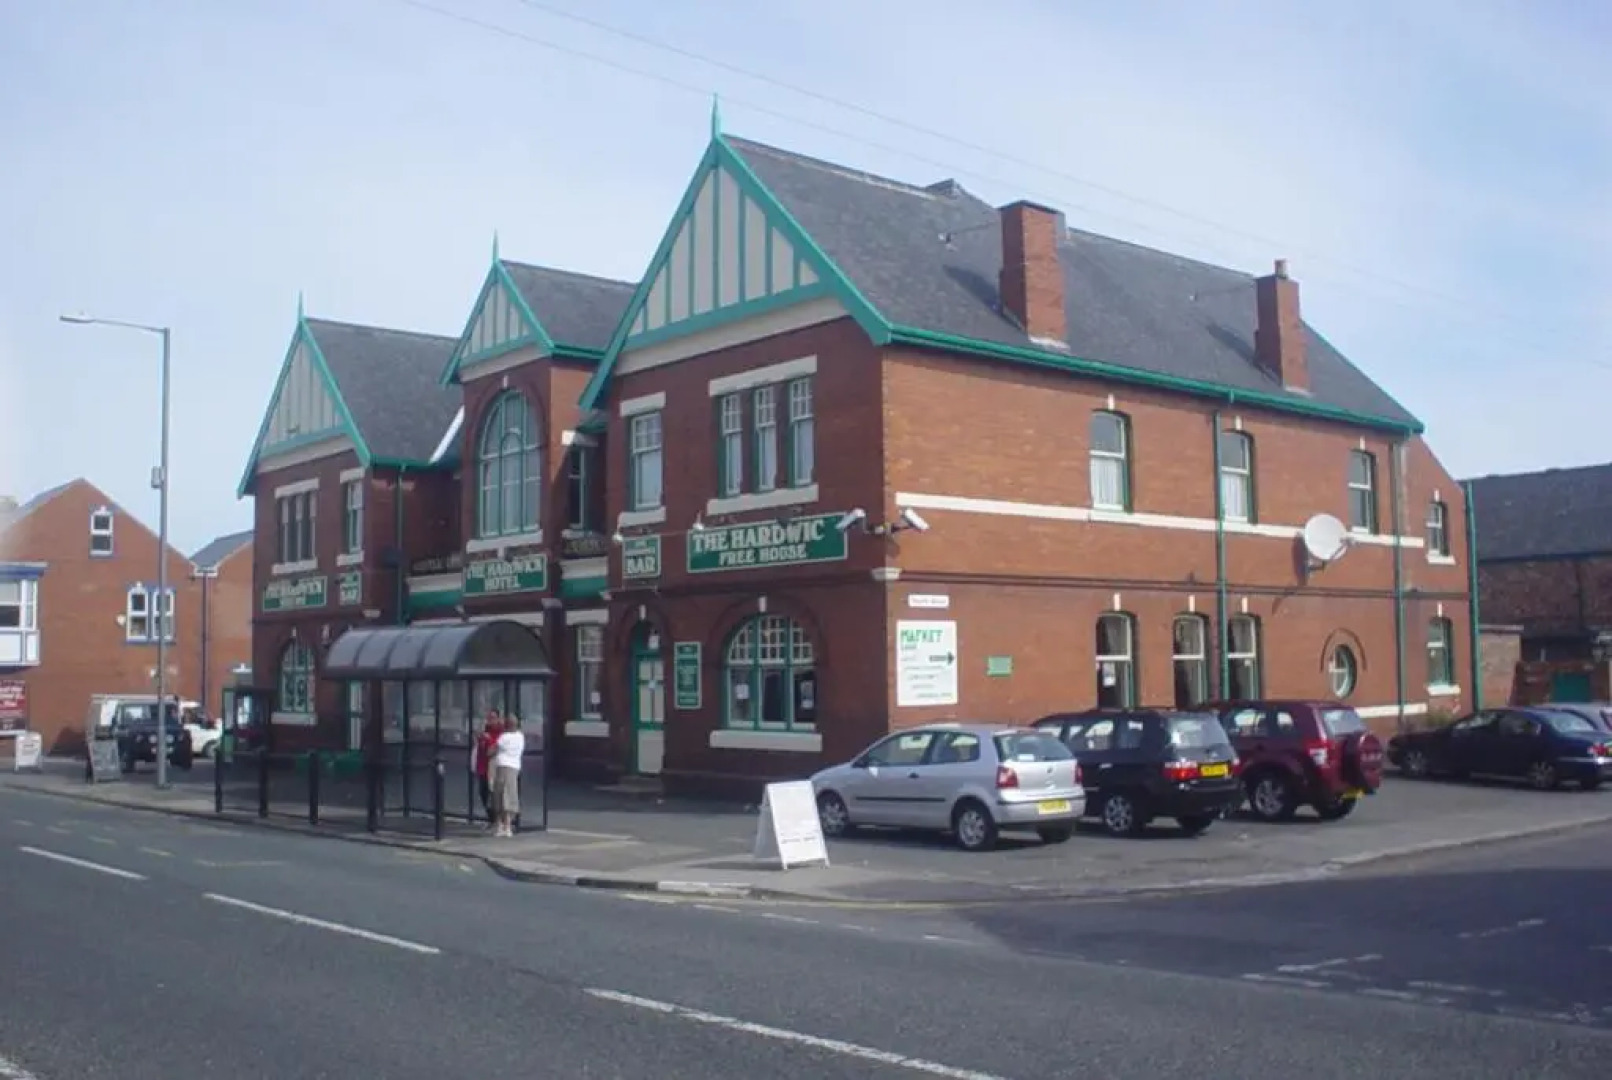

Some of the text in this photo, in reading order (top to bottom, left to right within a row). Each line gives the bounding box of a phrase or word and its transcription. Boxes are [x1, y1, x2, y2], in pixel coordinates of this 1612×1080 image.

[692, 531, 728, 553] THE
[628, 557, 655, 574] BAR
[719, 543, 807, 567] FREE HOUSE
